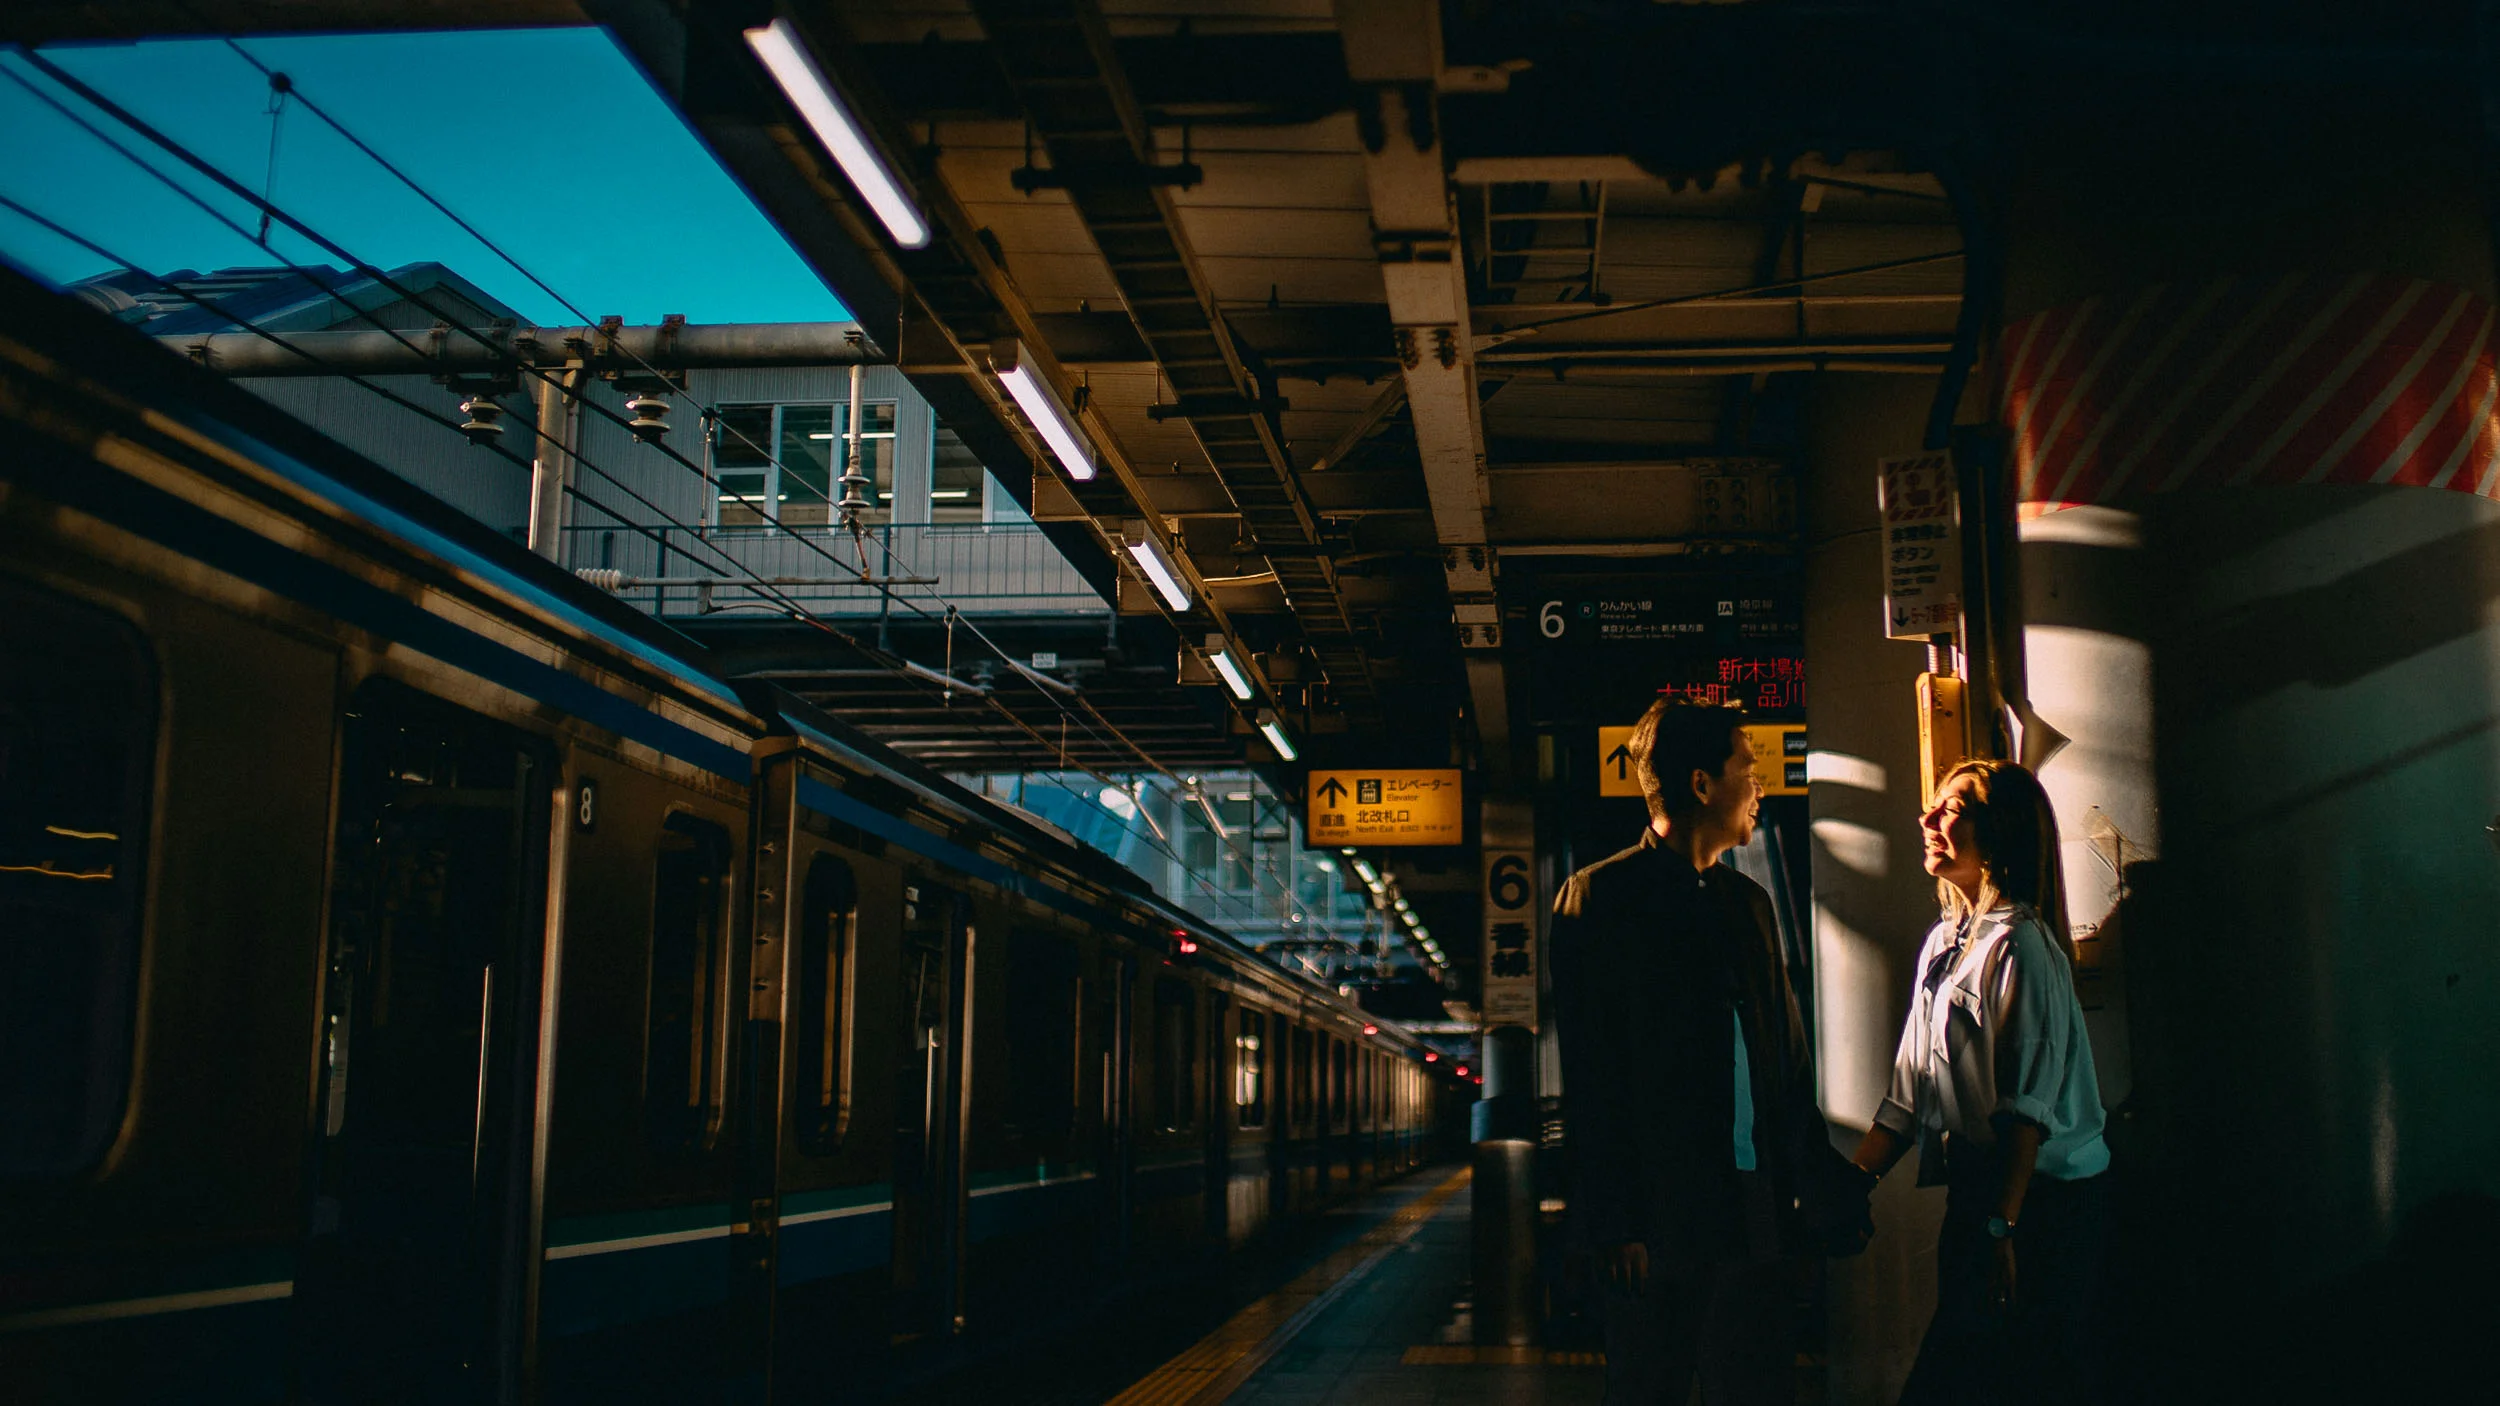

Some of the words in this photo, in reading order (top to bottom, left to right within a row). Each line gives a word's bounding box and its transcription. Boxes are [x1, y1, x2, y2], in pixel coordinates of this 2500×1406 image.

[1600, 600, 1653, 612] りんかい線
[1719, 603, 1733, 614] JA
[1540, 600, 1565, 639] 6
[1387, 779, 1453, 791] エレベーター
[1386, 794, 1418, 802] Elevator
[581, 786, 591, 825] 8
[1356, 810, 1409, 823] 北改札口
